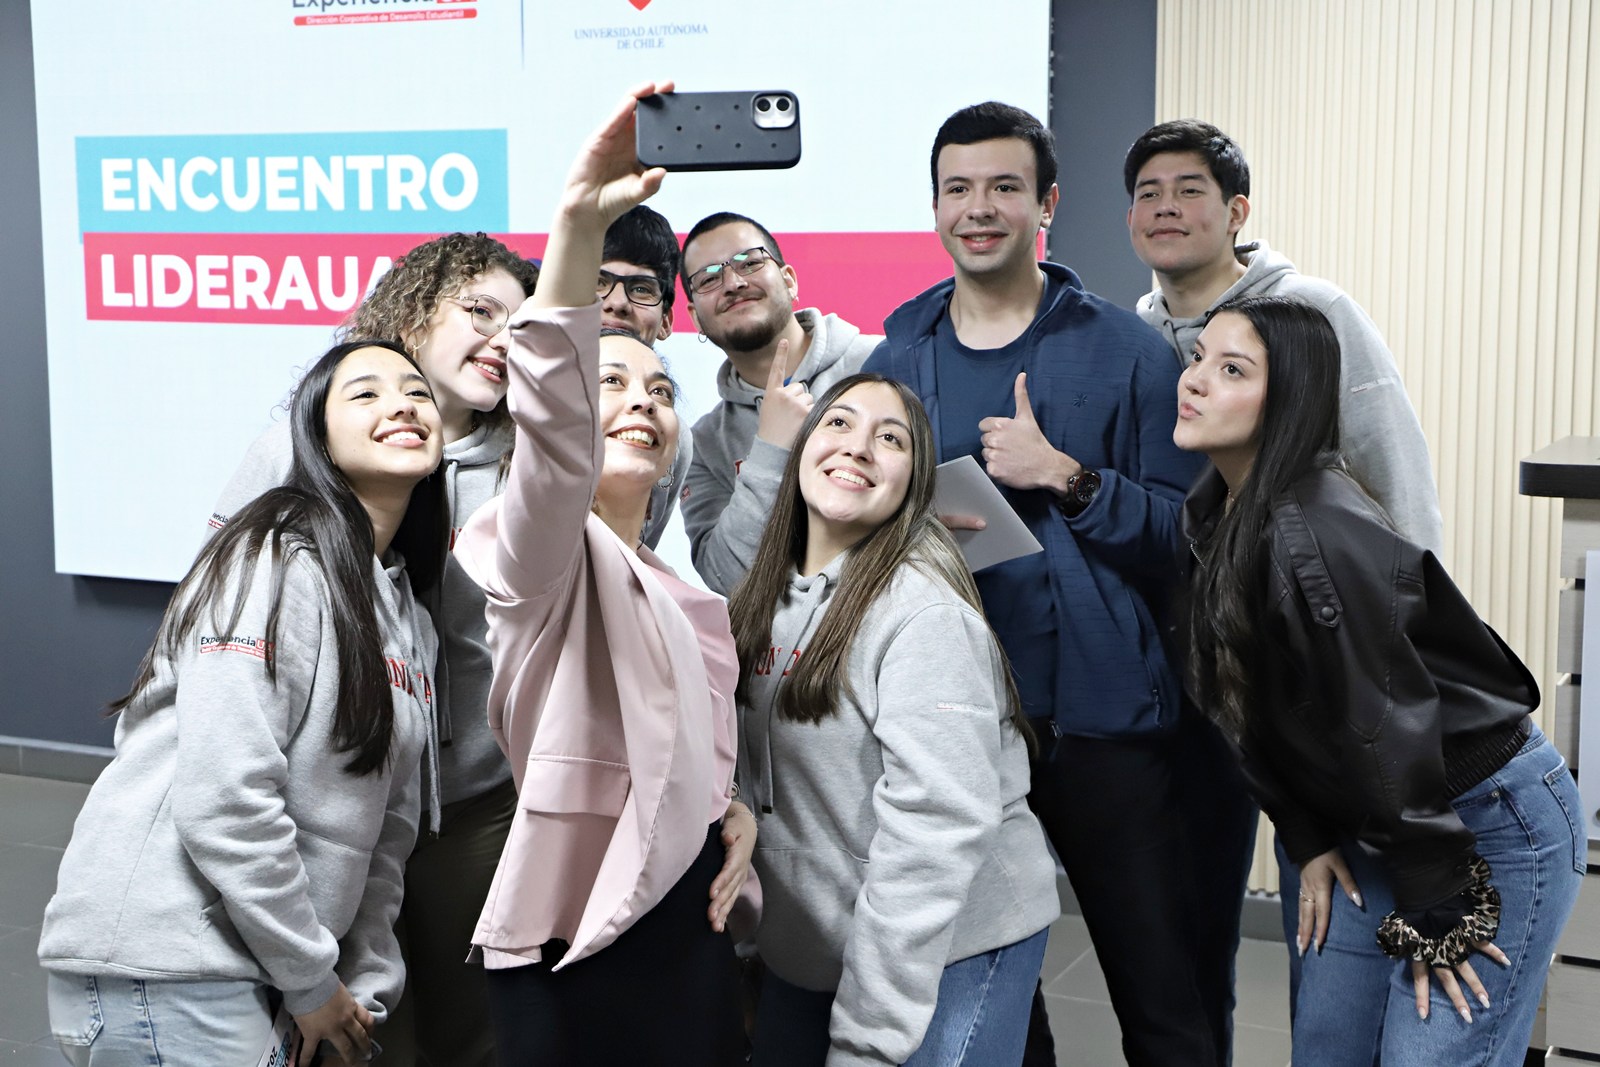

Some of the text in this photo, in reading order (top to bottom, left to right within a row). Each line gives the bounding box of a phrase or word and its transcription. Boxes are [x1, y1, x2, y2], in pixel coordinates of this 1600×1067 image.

[379, 13, 389, 22] de
[389, 11, 425, 21] Desarrollo
[425, 9, 464, 19] Estudiantil
[574, 23, 709, 39] UNIVERSIDAD AUTÓNOMA
[617, 38, 665, 50] DE CHILE
[101, 152, 479, 213] ENCUENTRO
